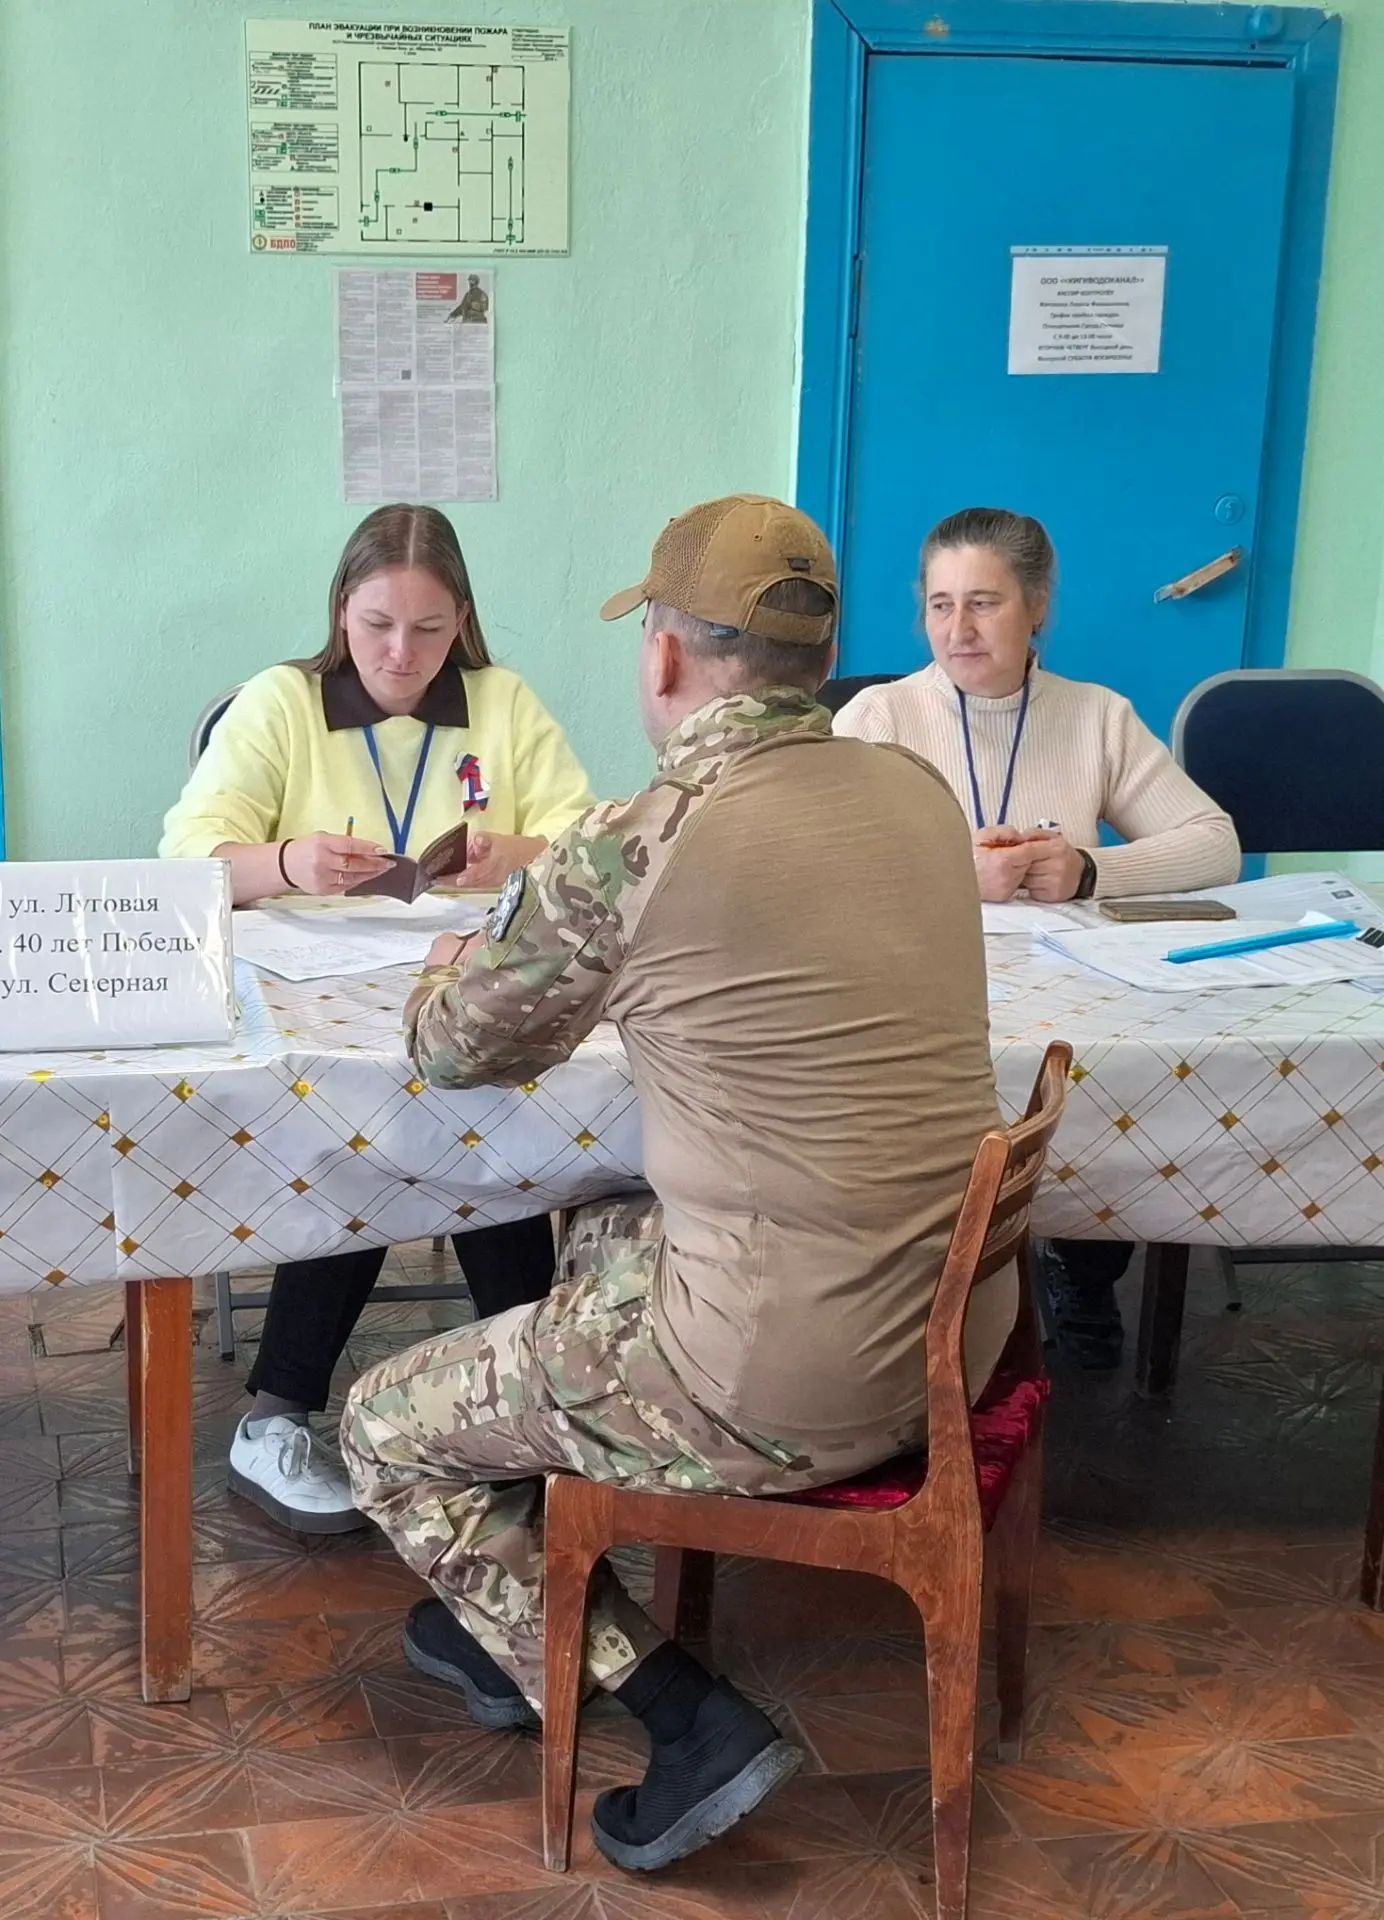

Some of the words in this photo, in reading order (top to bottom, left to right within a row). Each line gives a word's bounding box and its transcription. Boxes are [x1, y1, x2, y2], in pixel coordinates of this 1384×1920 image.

[309, 22, 331, 30] ПЛАН
[333, 23, 381, 32] ЭВАКУАЦИИ
[402, 25, 473, 34] ВОЗНИКНОВЕНИИ
[474, 27, 508, 35] ПОЖАРА
[346, 32, 352, 40] И
[424, 34, 472, 43] СИТУАЦИЯХ
[270, 239, 296, 249] БДПО
[9, 899, 45, 919] ул.
[55, 893, 159, 913] Луговая
[13, 933, 42, 953] 40
[50, 937, 93, 953] лет
[1, 978, 38, 999] ул.
